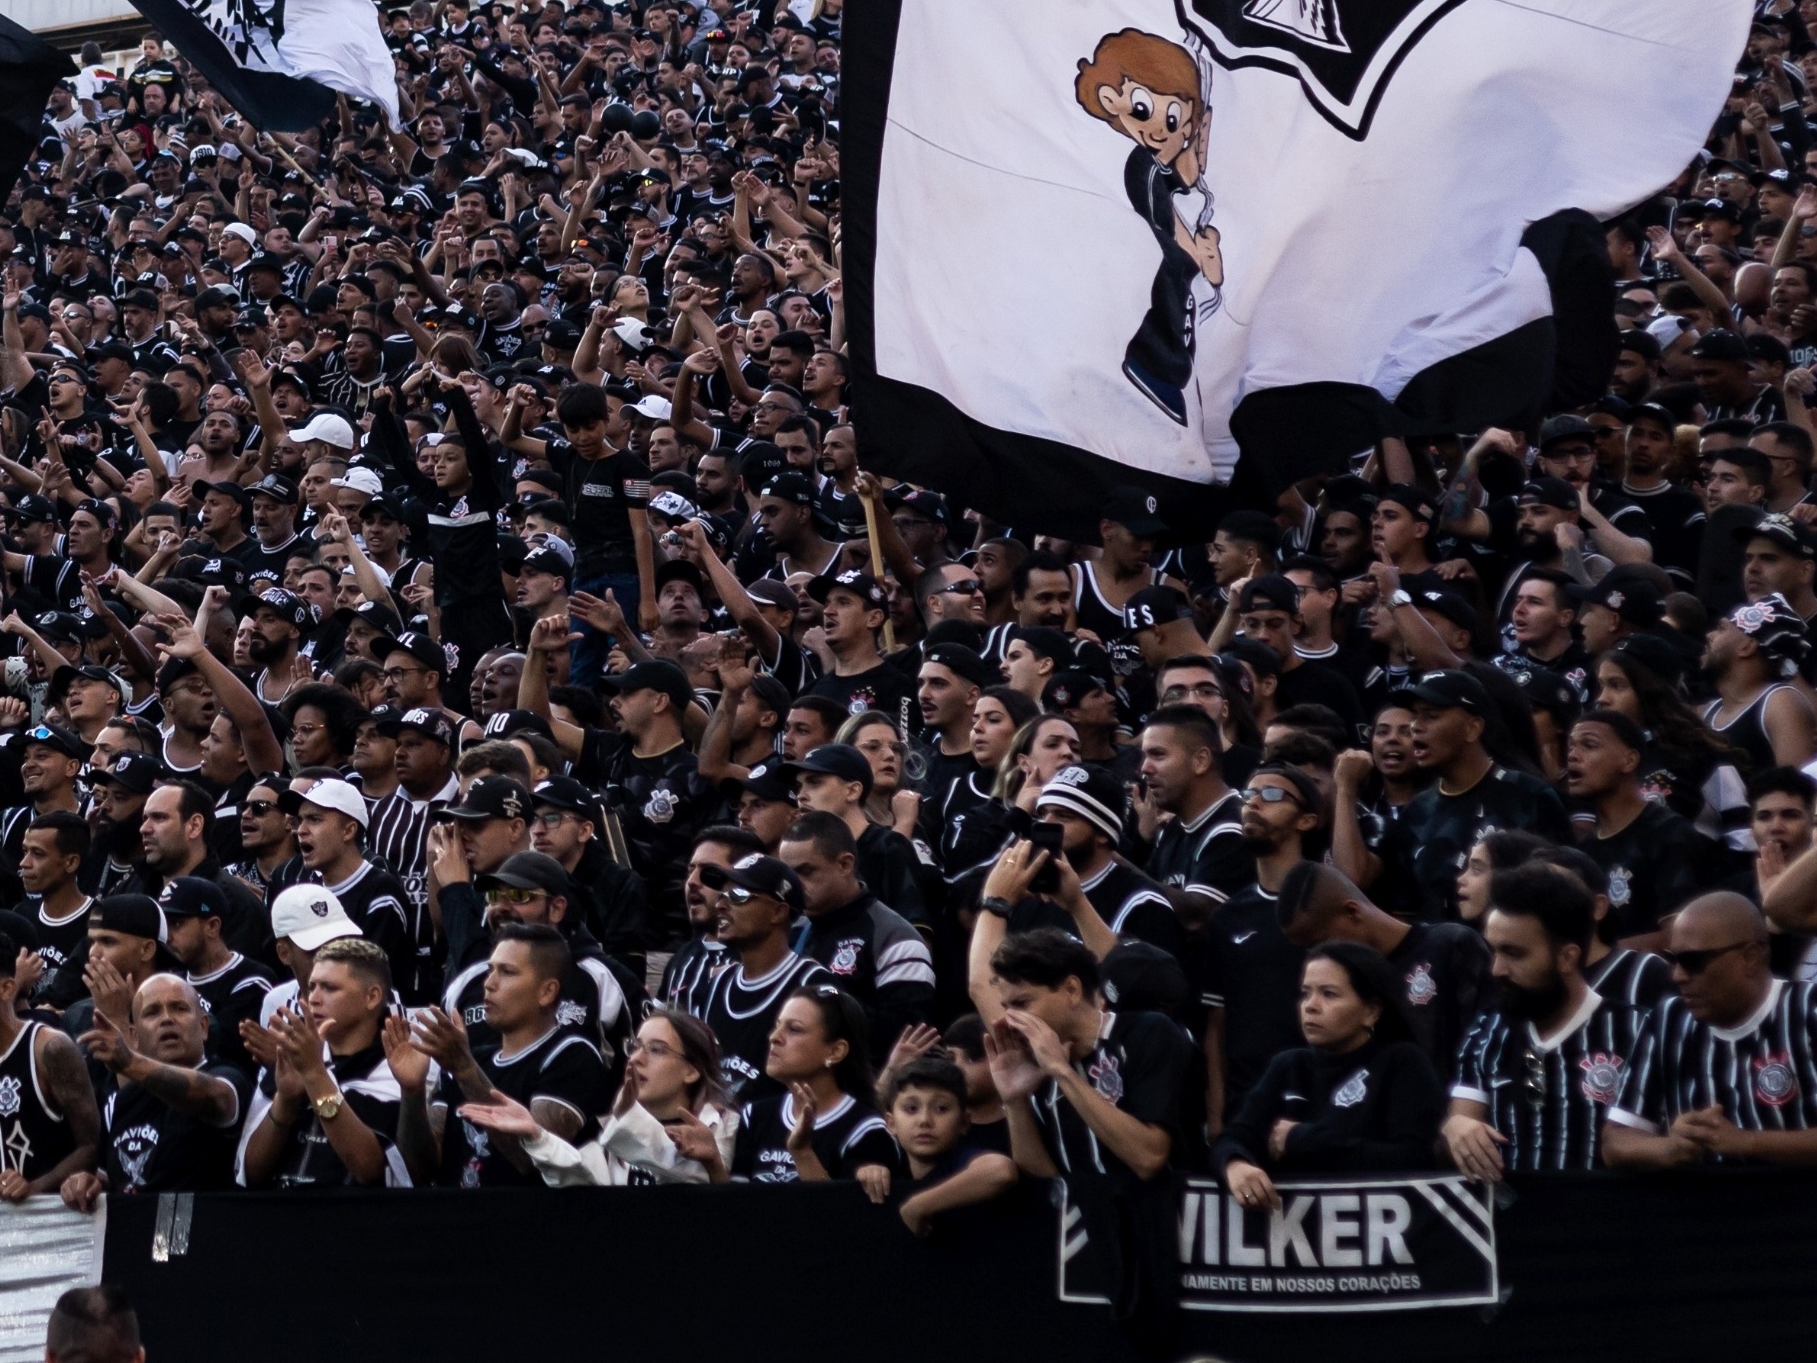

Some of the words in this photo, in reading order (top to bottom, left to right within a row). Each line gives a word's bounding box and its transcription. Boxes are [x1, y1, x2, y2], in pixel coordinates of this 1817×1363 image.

[249, 568, 279, 581] AVIÕES
[37, 945, 69, 965] VIÕES
[719, 1053, 761, 1080] VIÕES
[128, 1141, 143, 1152] DA
[774, 1165, 787, 1175] DA
[1251, 1277, 1273, 1293] EM
[1276, 1277, 1336, 1294] NOSSOS
[1338, 1271, 1422, 1295] CORAÇÕES
